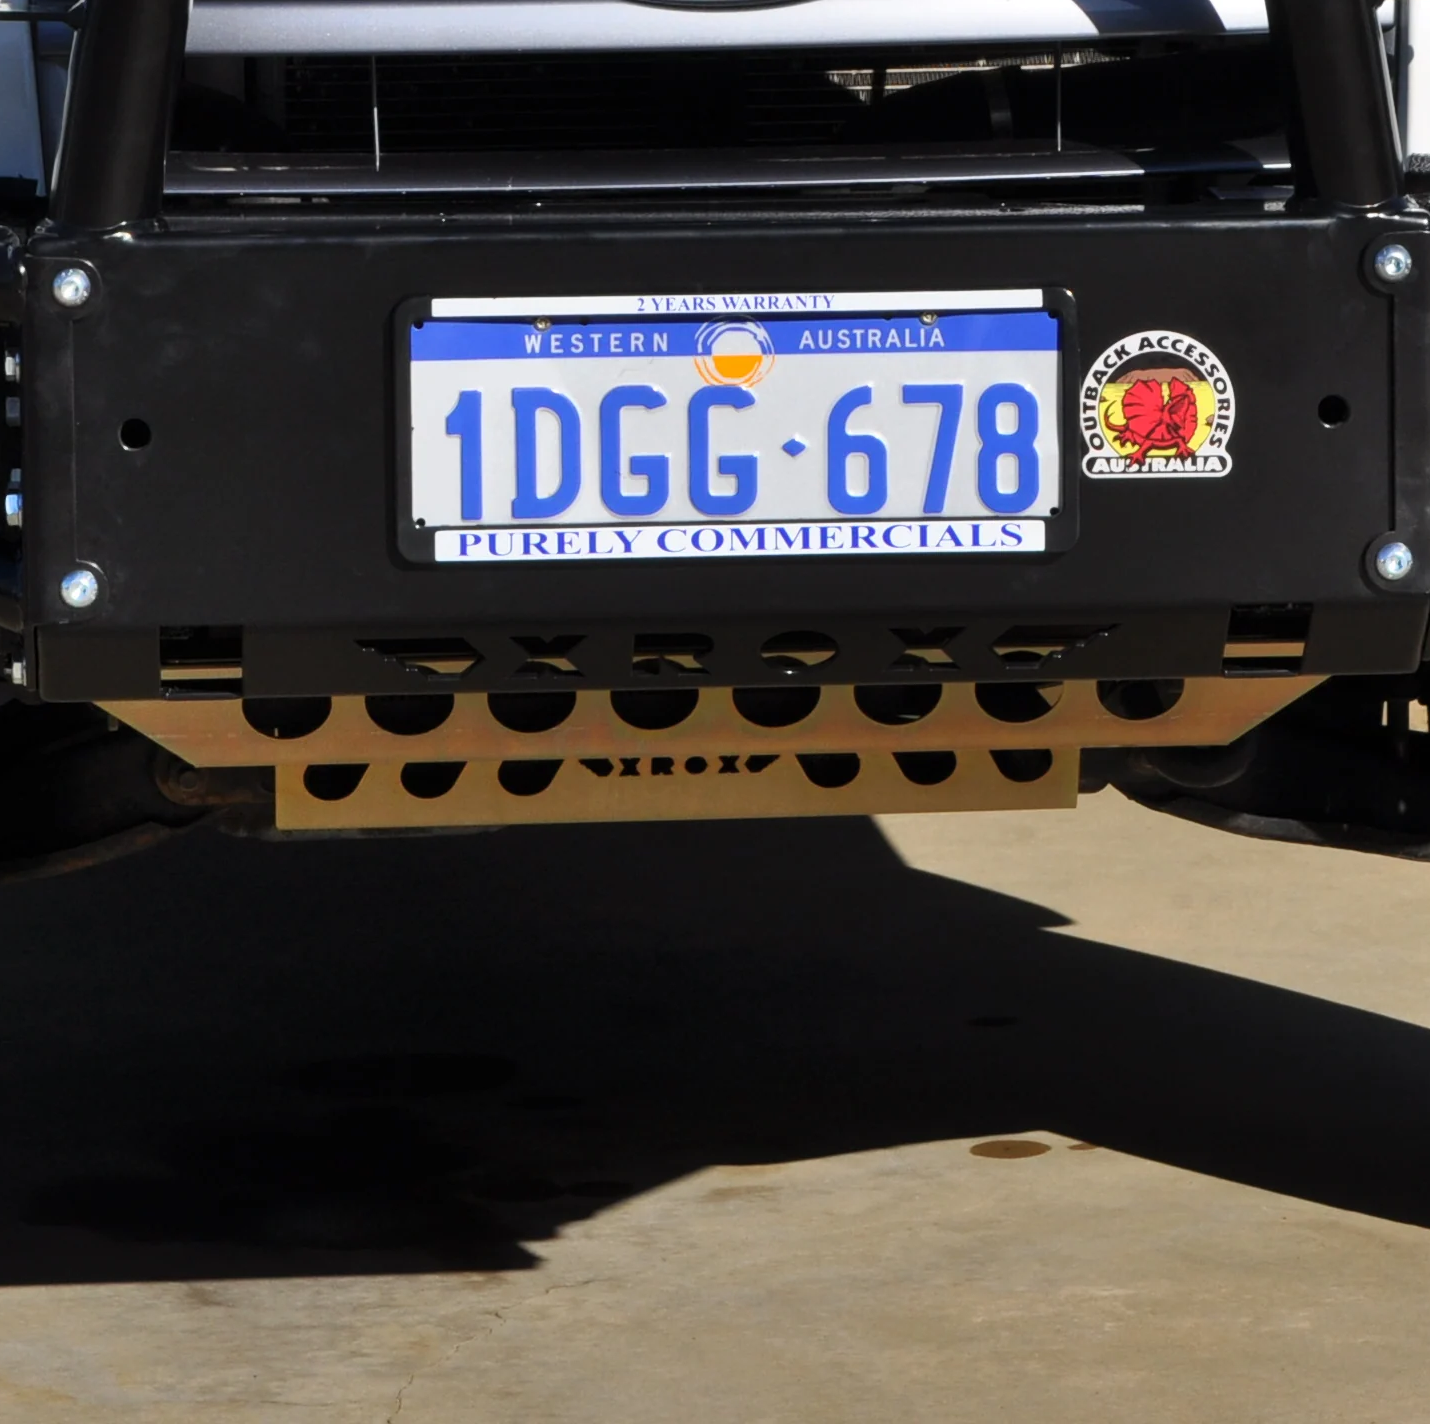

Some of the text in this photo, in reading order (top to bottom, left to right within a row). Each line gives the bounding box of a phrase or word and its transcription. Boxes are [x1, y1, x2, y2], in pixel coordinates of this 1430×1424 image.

[637, 294, 835, 312] 2 YEARS WARRANTY
[524, 328, 945, 354] WESTERN AUSTRALIA
[1083, 336, 1231, 451] OUTBACK ACCESSORIES
[1091, 456, 1223, 473] AUSTRALIA
[457, 522, 1024, 558] PURELY COMMERCIALS
[509, 627, 967, 677] XROX
[618, 754, 740, 777] XROX
